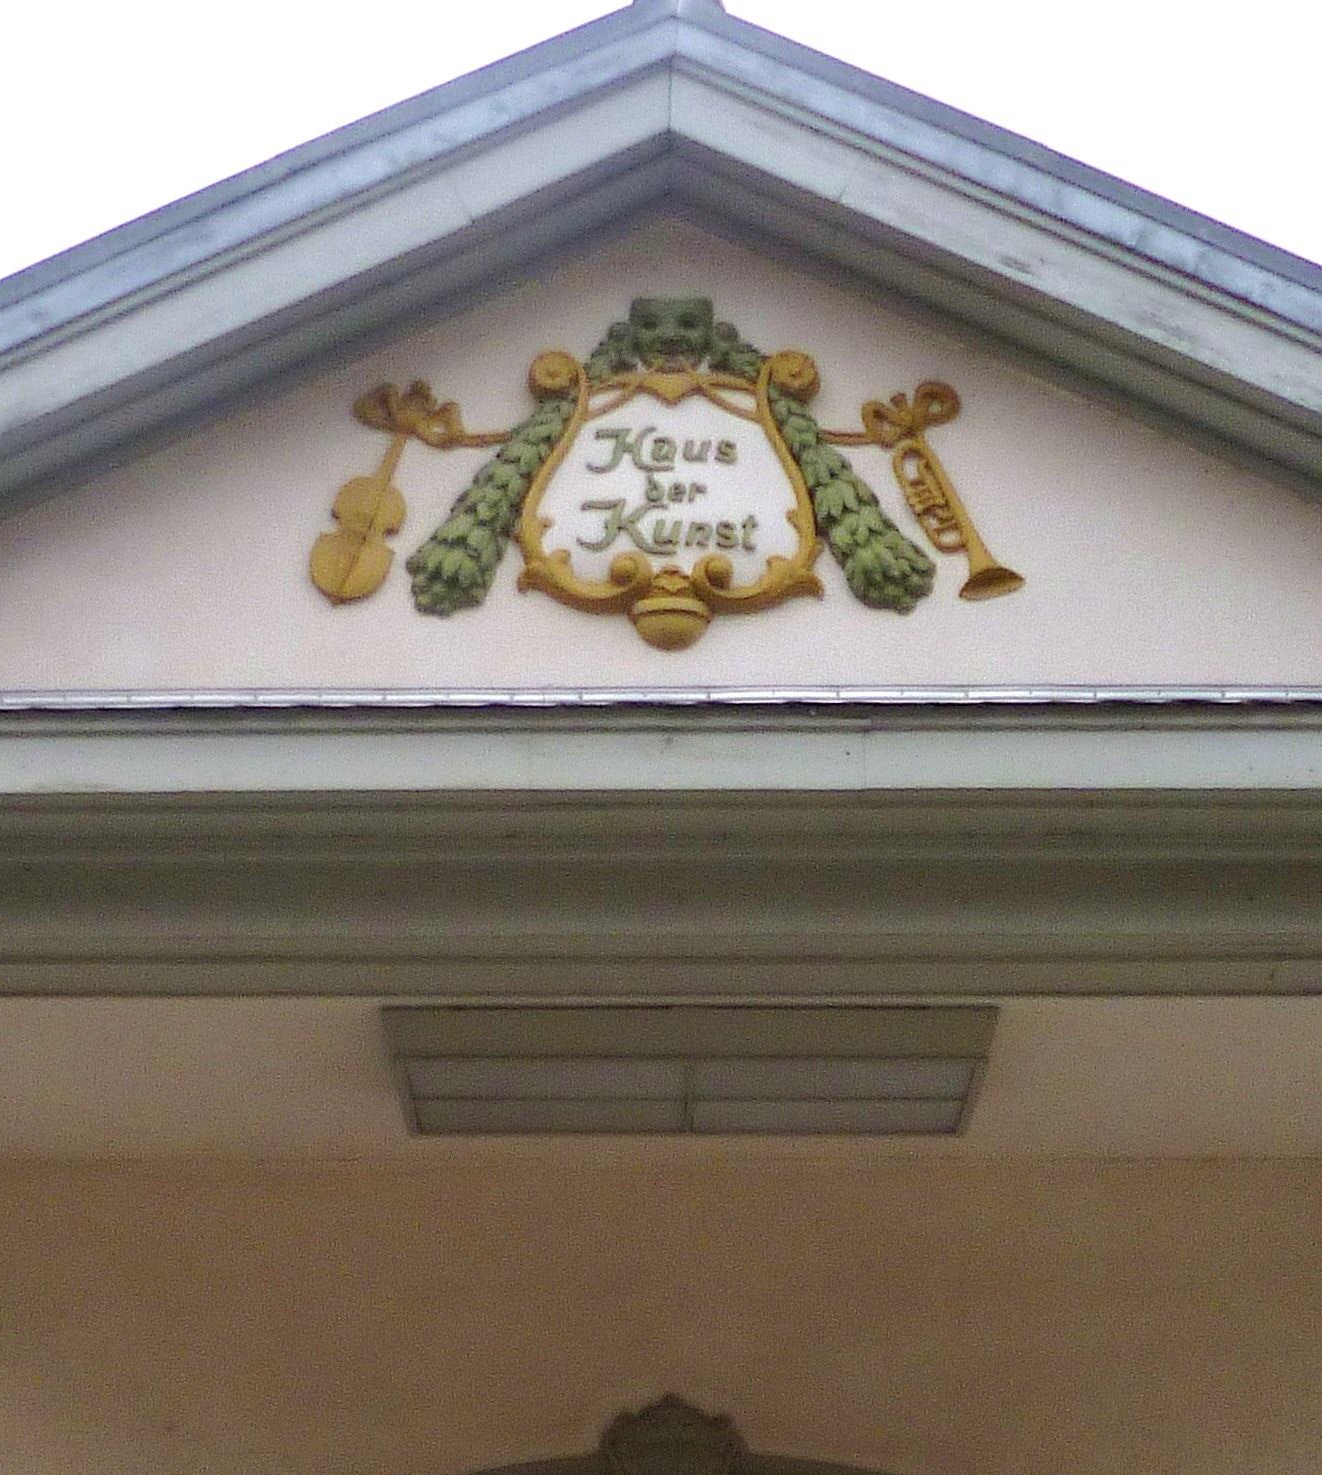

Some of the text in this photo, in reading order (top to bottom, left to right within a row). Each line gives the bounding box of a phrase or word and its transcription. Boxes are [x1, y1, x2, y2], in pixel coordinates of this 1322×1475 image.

[586, 426, 739, 474] Haus
[645, 472, 707, 503] der
[577, 499, 759, 556] Kunst
